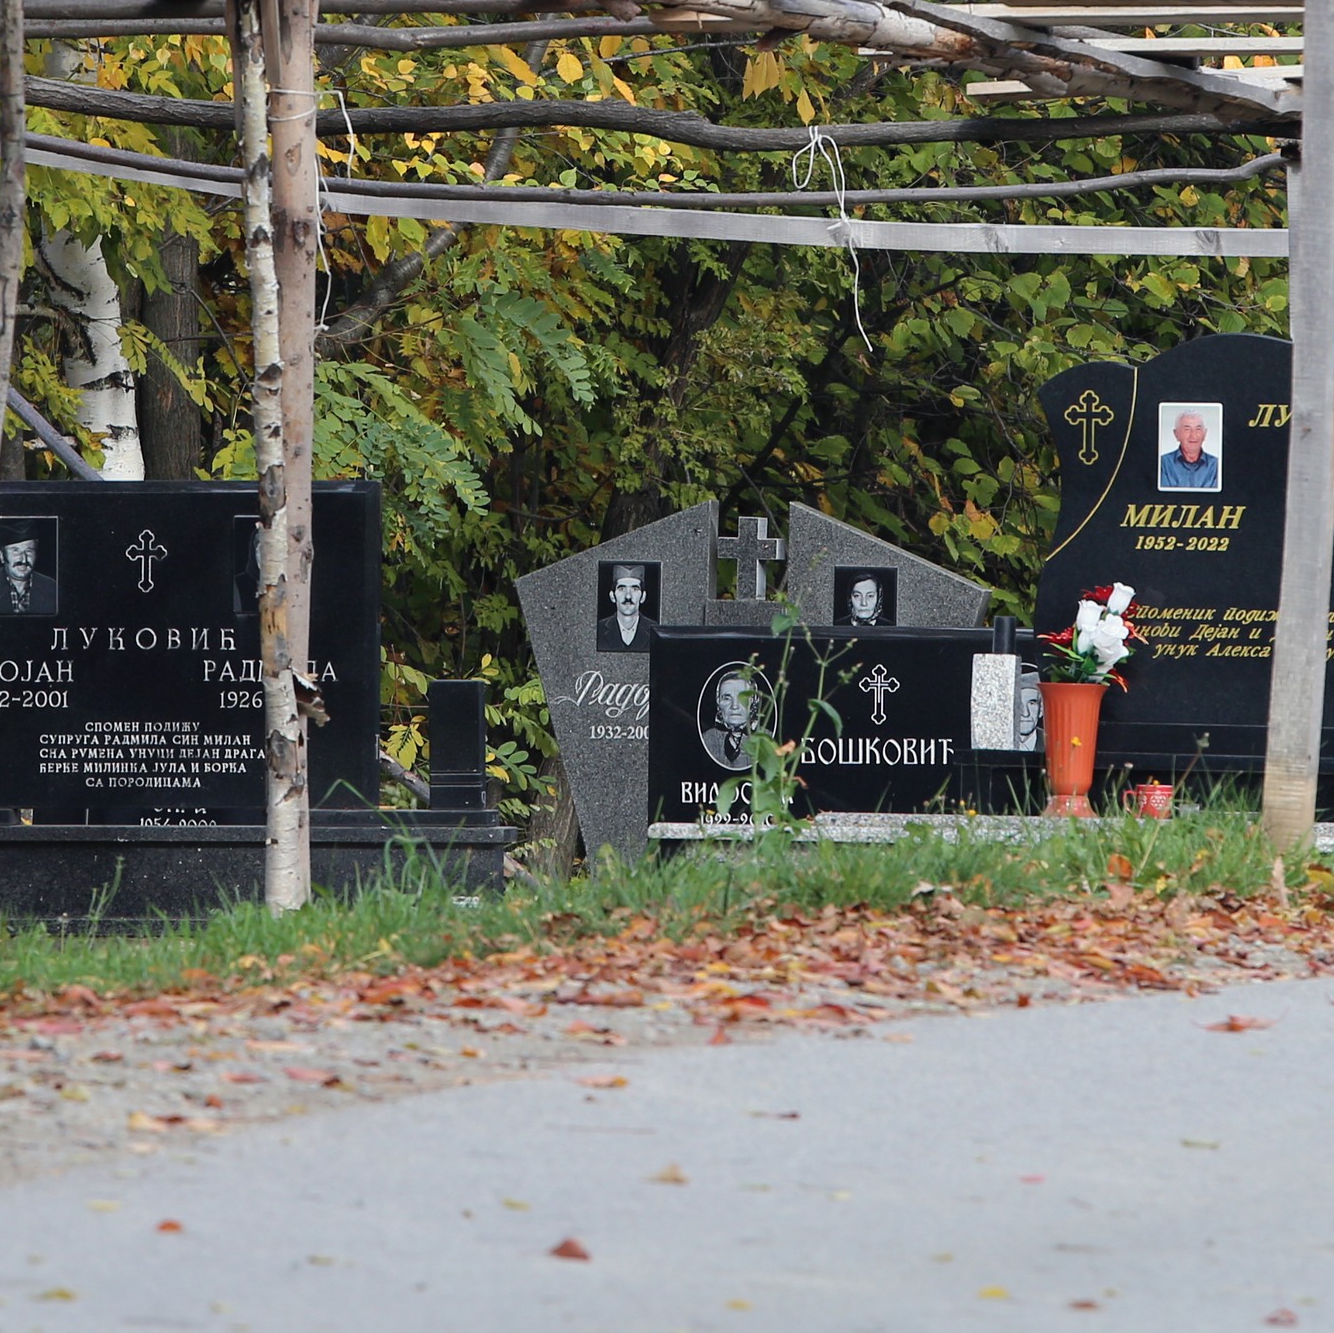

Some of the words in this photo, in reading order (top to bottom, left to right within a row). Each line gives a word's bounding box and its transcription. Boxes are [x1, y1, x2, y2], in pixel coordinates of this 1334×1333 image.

[1120, 504, 1247, 530] МИЛАН
[1134, 535, 1230, 553] 1952-2022
[1189, 624, 1240, 641] Дејан
[1248, 627, 1263, 640] и
[1152, 643, 1199, 659] унук
[1205, 643, 1272, 658] Алекса
[85, 722, 140, 733] СПОМЕН
[144, 722, 200, 733] ПОДИЖУ
[589, 725, 649, 740] 1932-200
[39, 734, 100, 745] СУПРУГА
[104, 734, 168, 746] РАДМИЛА
[172, 734, 199, 745] СИН
[203, 735, 252, 746] МИЛАН
[39, 748, 68, 759] СНА
[71, 748, 125, 759] РУМЕНА
[178, 748, 221, 759] ДЕЈАН
[224, 748, 266, 759] ДРАГА
[83, 762, 148, 773] МИЛИНКА
[190, 762, 200, 773] И
[85, 777, 104, 788] СА
[108, 777, 202, 788] ПОРОДИЦАМА
